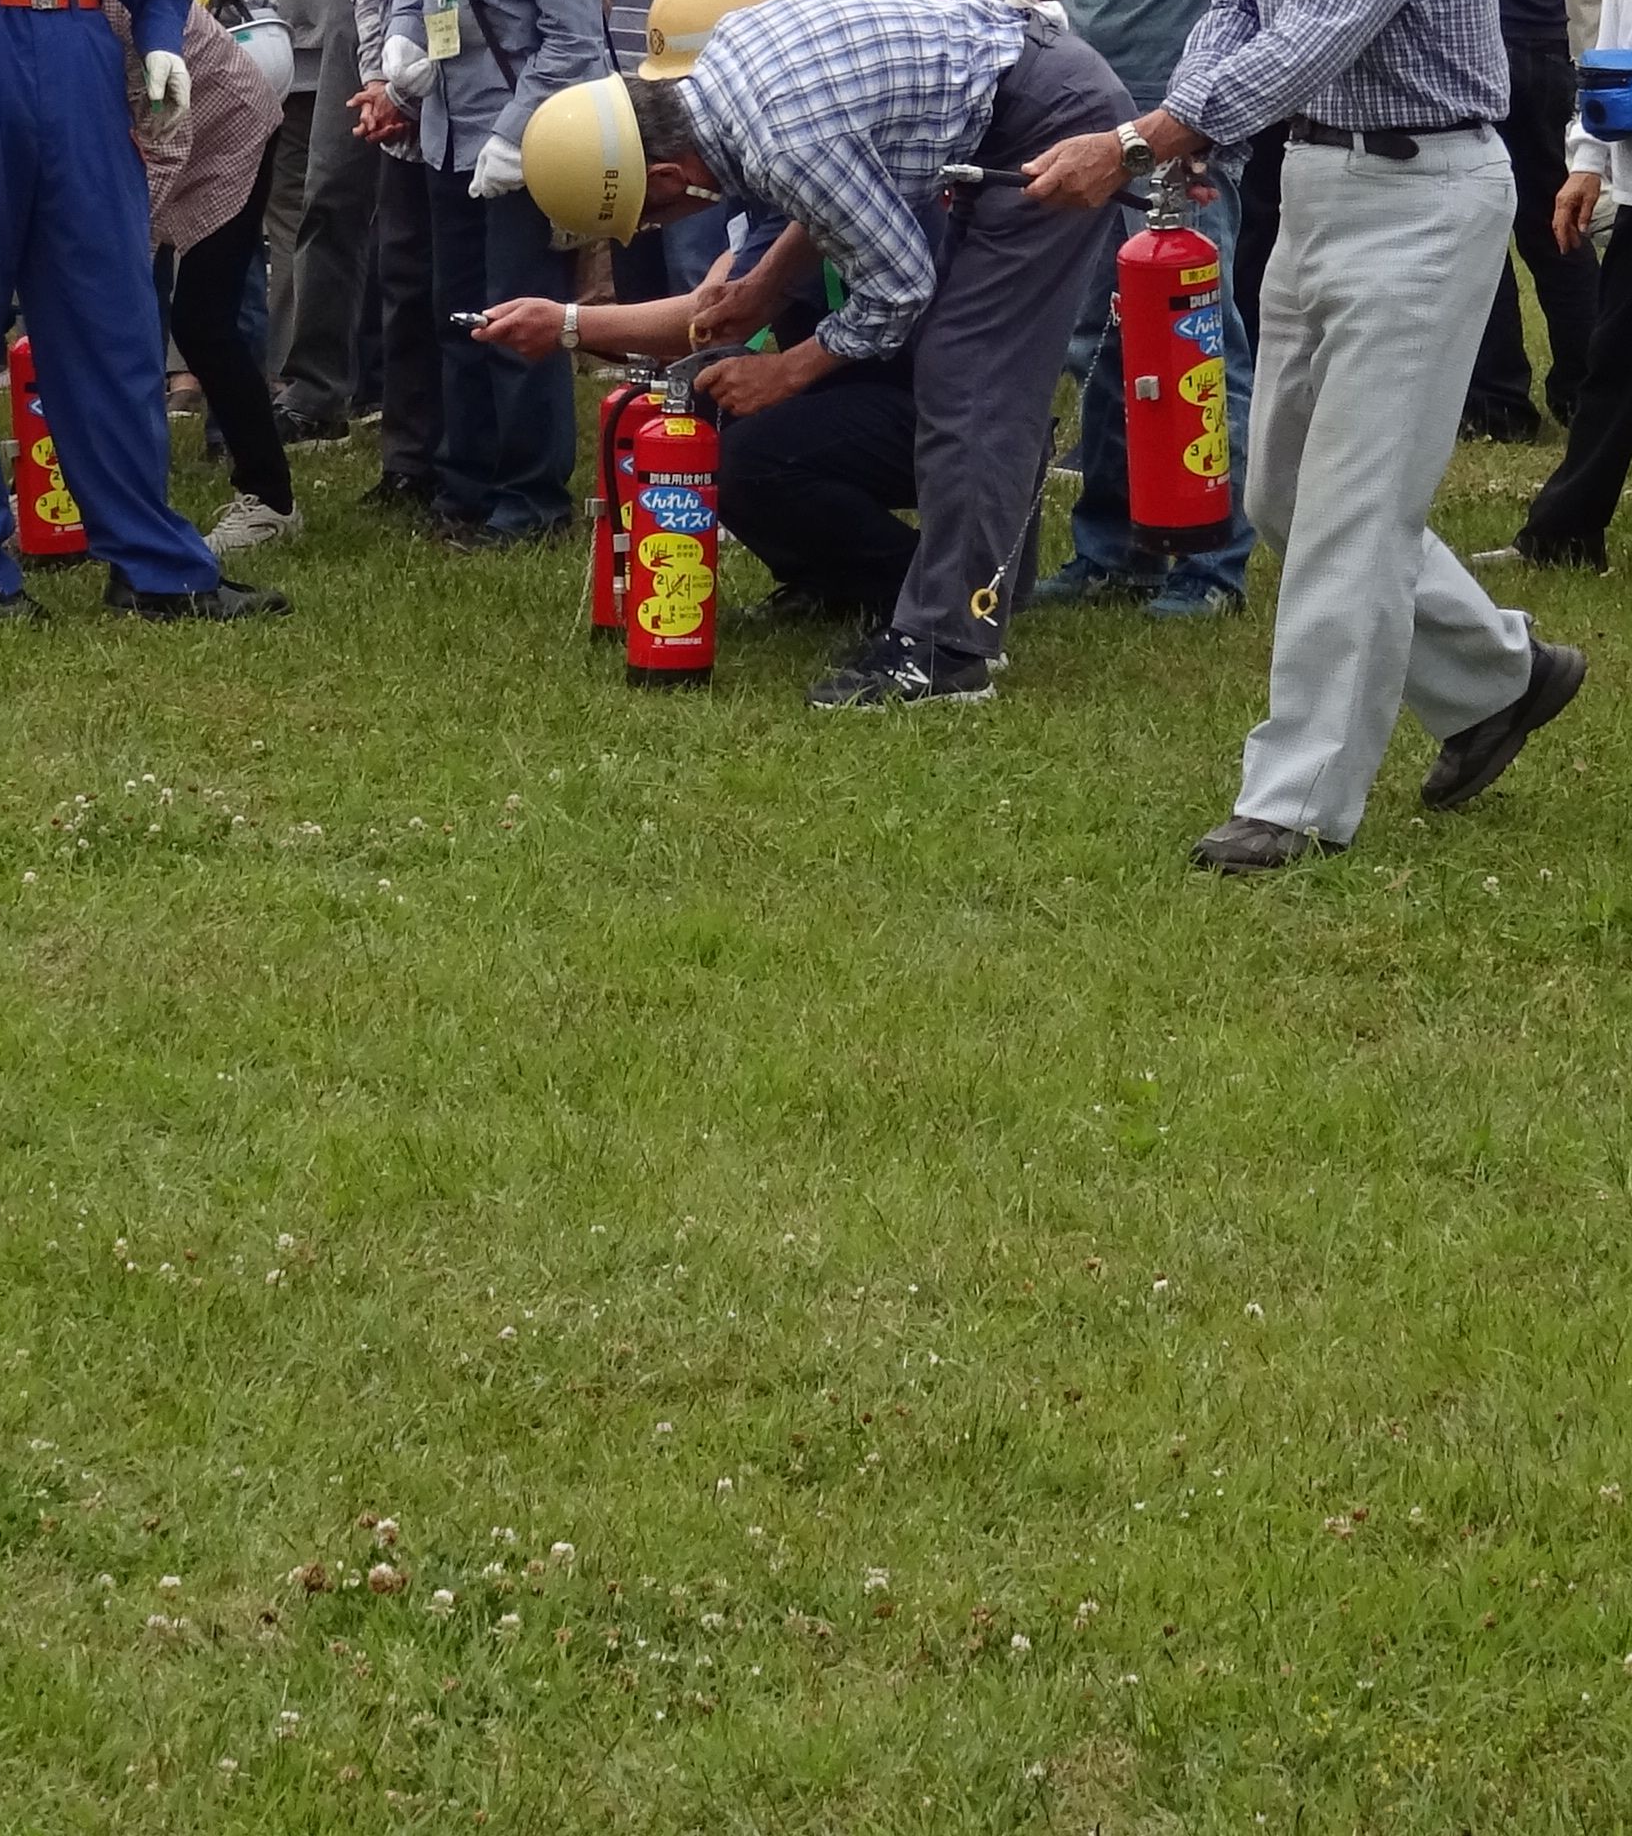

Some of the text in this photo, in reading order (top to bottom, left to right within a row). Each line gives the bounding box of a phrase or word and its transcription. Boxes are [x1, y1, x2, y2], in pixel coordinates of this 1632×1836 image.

[641, 491, 699, 509] くんれん
[660, 511, 712, 528] スイスイ
